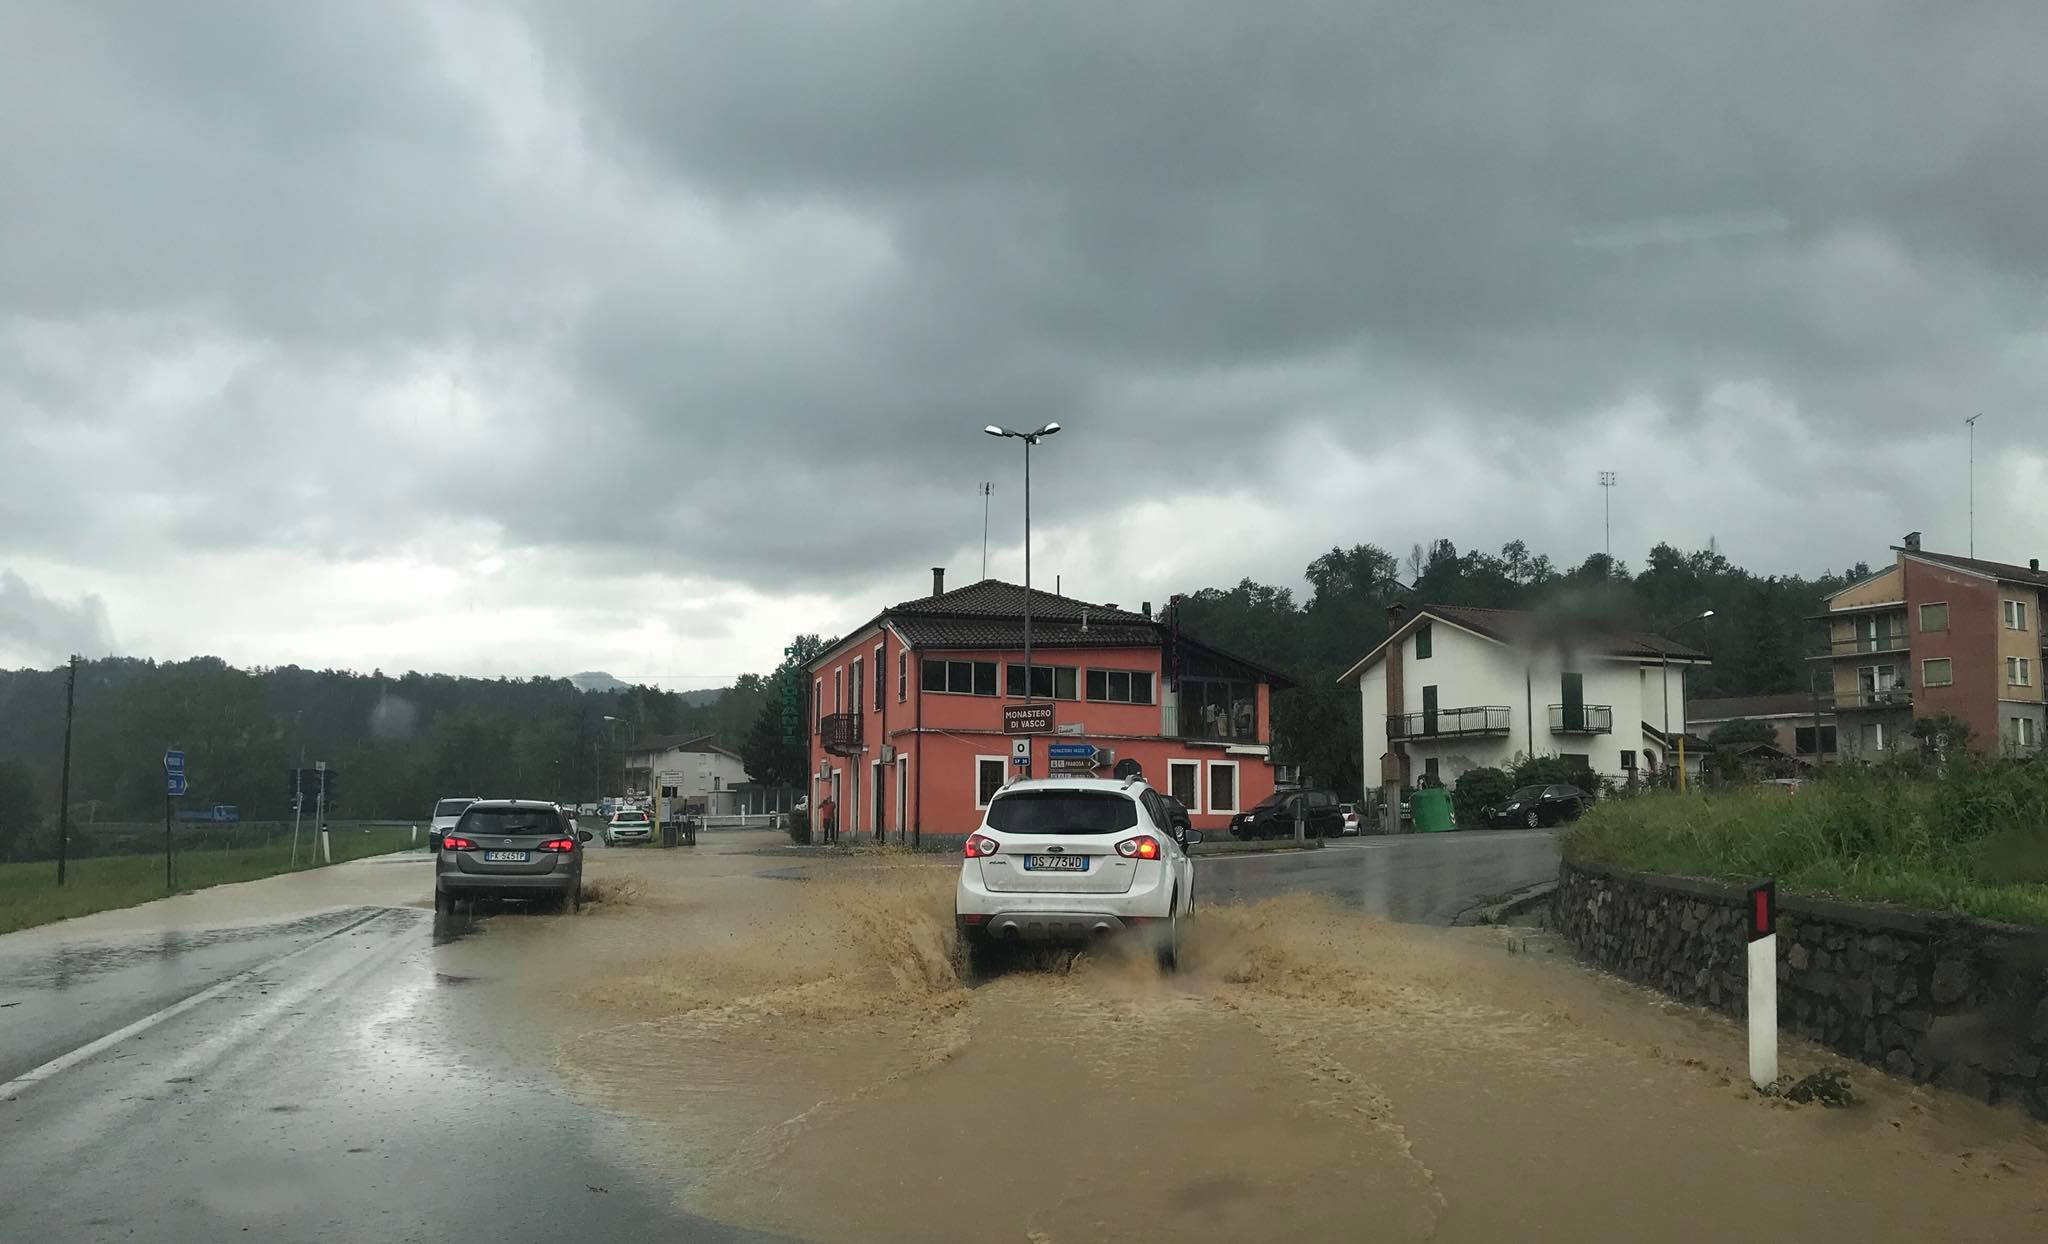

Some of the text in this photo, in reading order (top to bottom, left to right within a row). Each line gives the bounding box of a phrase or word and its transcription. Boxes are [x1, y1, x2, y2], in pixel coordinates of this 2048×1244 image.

[1005, 709, 1051, 719] MONASTERO
[1011, 719, 1046, 729] DI VASCO
[1031, 856, 1082, 868] DS 773WD
